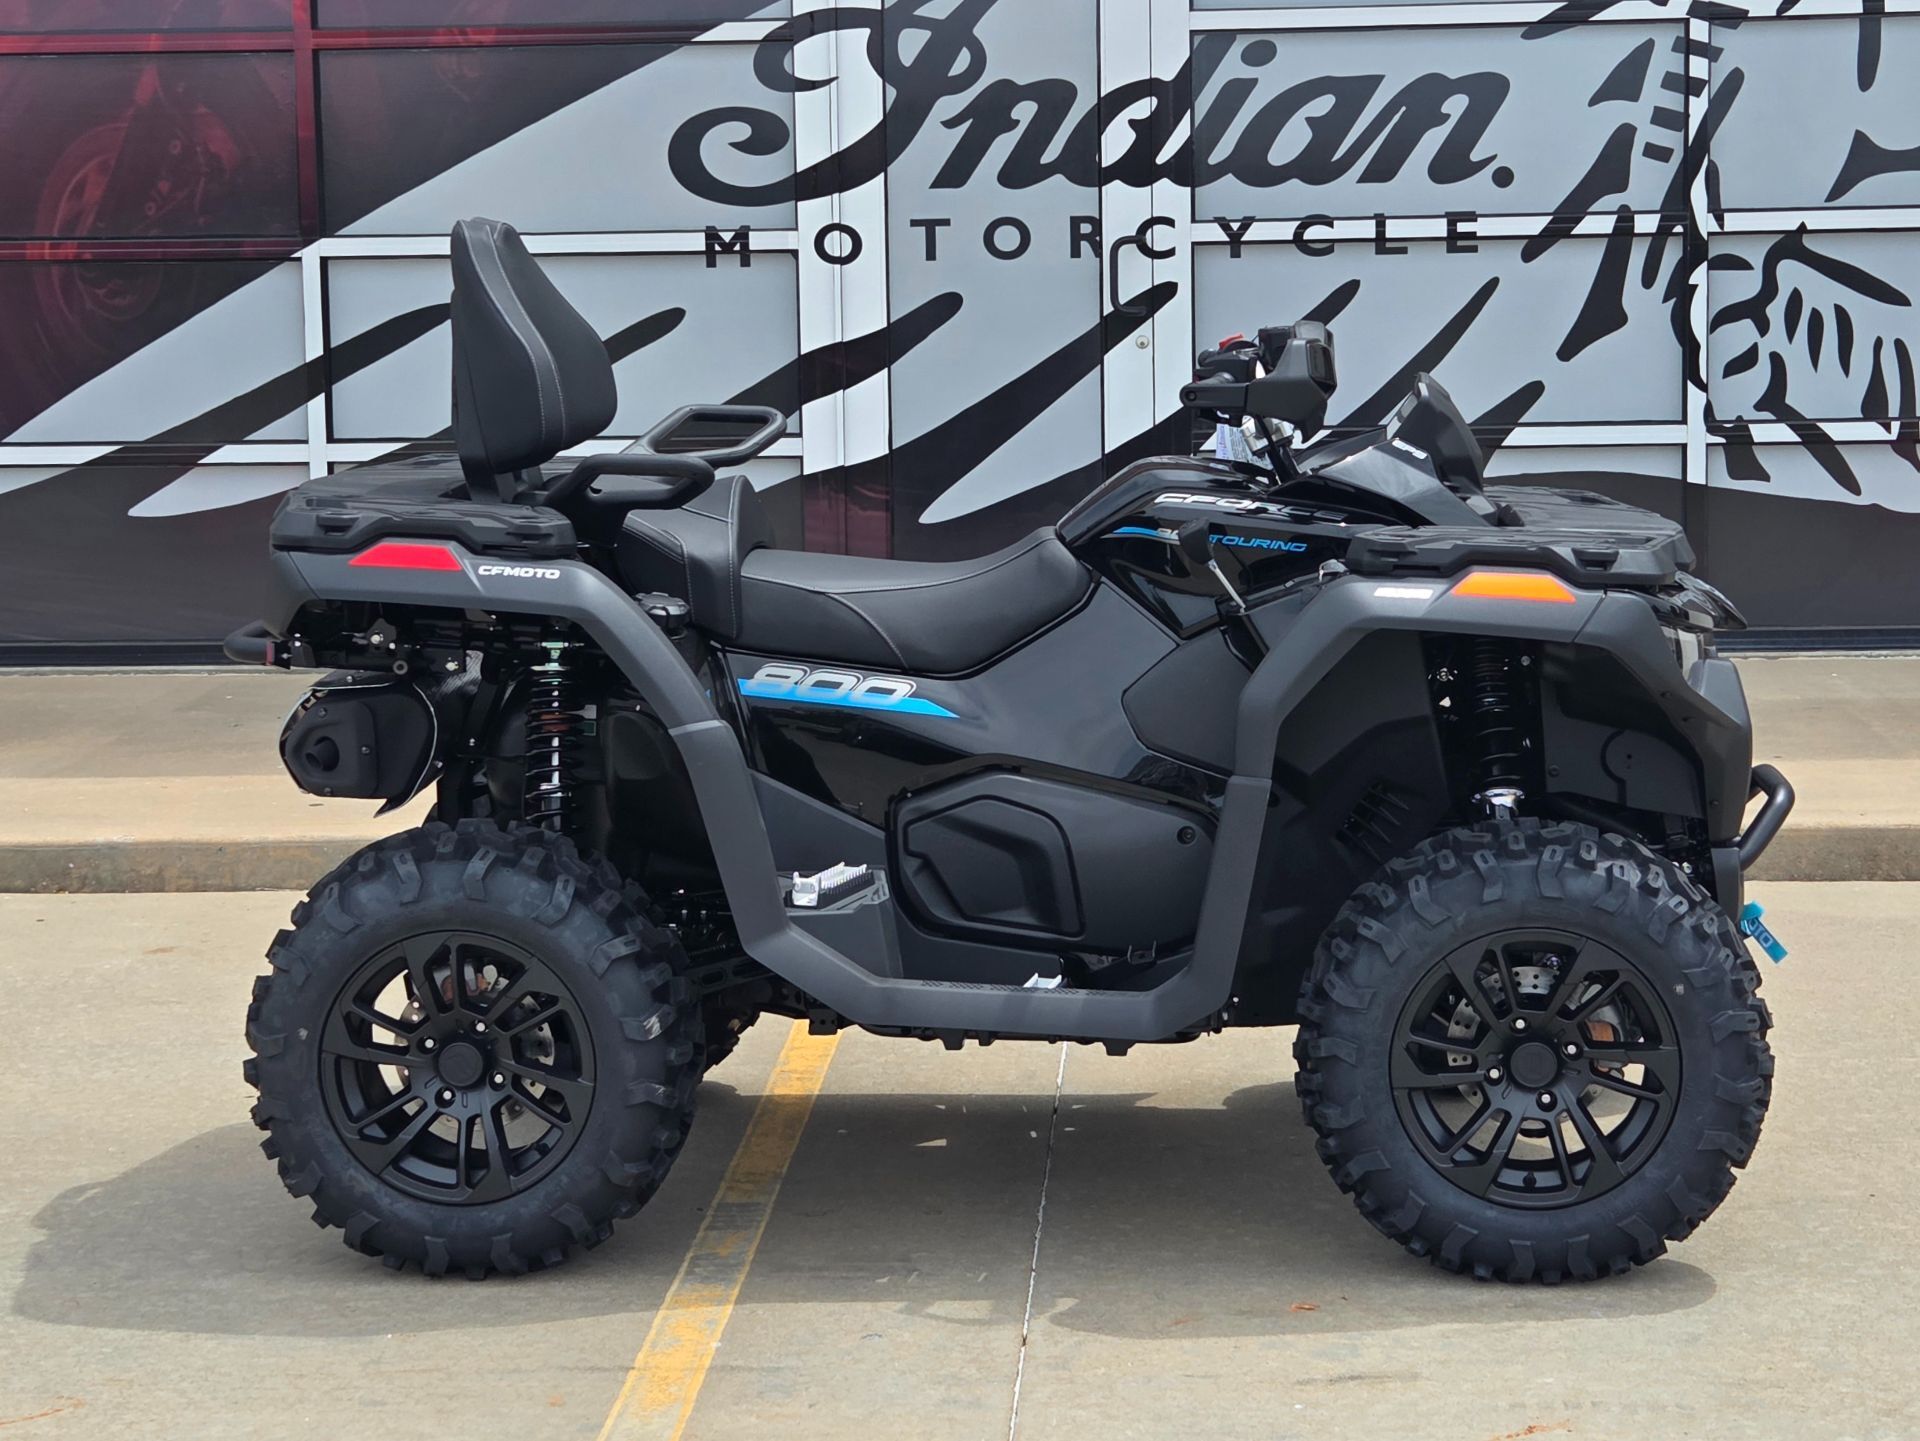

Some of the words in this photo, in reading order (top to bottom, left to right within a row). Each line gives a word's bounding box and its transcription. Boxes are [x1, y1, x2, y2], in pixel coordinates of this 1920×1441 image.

[704, 210, 1479, 269] MOTORCYCLE
[1208, 533, 1308, 552] TOURING
[478, 565, 561, 580] CFMOTO
[749, 662, 918, 706] 800
